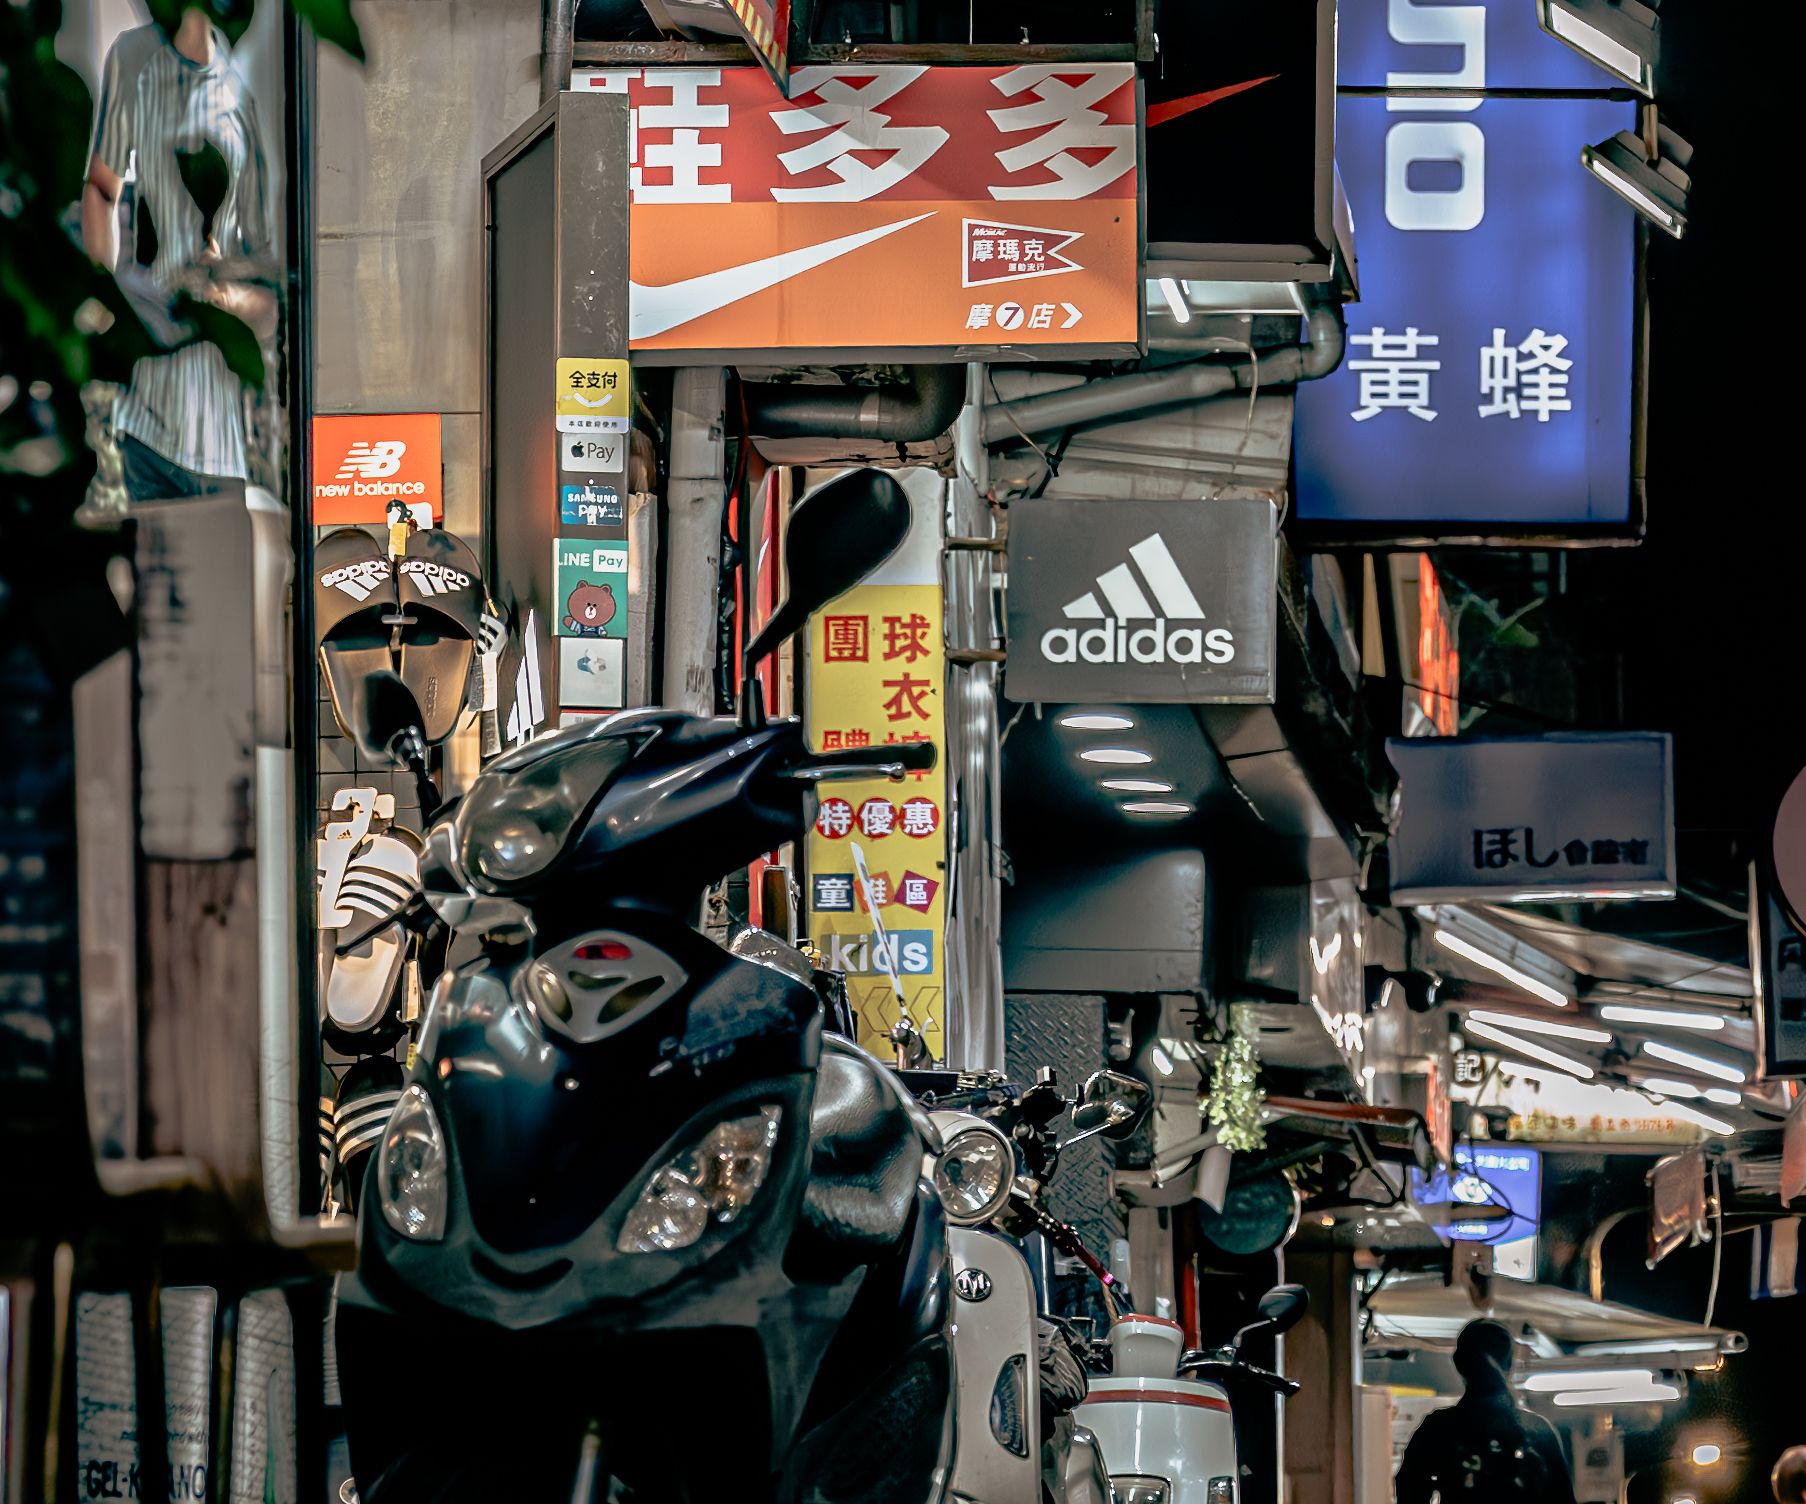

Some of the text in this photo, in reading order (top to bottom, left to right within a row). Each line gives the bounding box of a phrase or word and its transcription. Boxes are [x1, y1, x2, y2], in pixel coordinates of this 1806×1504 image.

[972, 239, 1045, 262] 摩瑪克
[569, 371, 618, 389] 全支付
[1348, 325, 1573, 422] 黃蜂
[587, 443, 615, 463] Pay
[316, 480, 425, 497] new balance
[399, 559, 471, 588] adidas
[559, 553, 623, 568] INE Pay
[1040, 619, 1235, 664] adidas
[819, 800, 935, 836] 特優惠
[831, 933, 929, 973] kids
